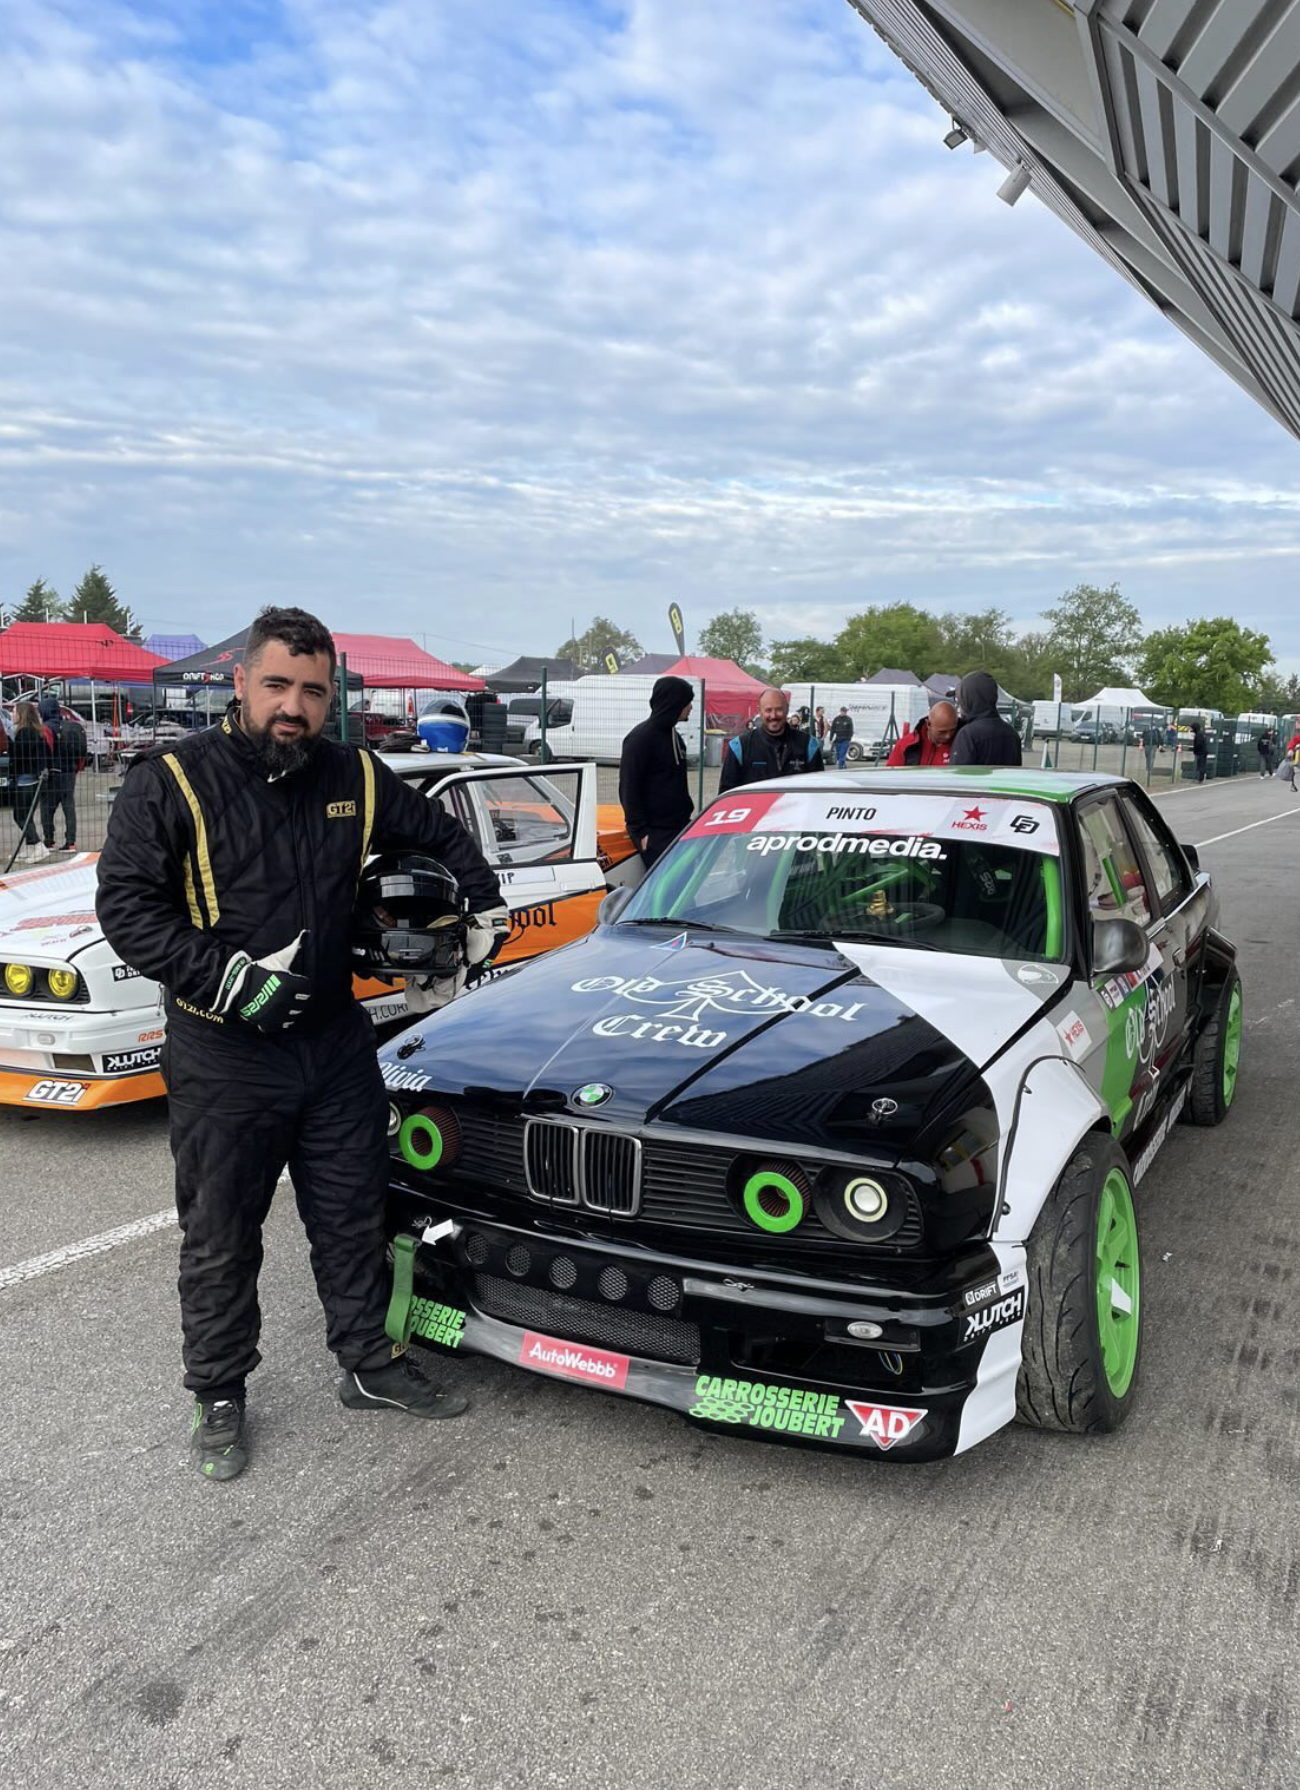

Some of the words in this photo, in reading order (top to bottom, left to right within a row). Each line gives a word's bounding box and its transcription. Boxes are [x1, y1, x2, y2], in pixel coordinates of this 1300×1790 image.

[704, 808, 752, 826] 19
[825, 806, 877, 821] PINTO
[951, 820, 988, 831] HEXIS
[746, 832, 948, 860] aprodmedia.
[571, 976, 664, 995] Old
[675, 979, 868, 1021] School
[138, 1029, 163, 1043] RRS
[592, 1014, 727, 1048] Crew
[107, 1047, 161, 1068] KLUTCH
[28, 1080, 91, 1102] GT2i
[974, 1284, 997, 1301] DRIFT
[965, 1292, 1022, 1335] KLUTCH
[529, 1342, 616, 1378] AutoWebbb
[695, 1375, 841, 1416] CARROSSERIE
[750, 1405, 845, 1438] JOUBERT
[859, 1409, 910, 1439] AD
